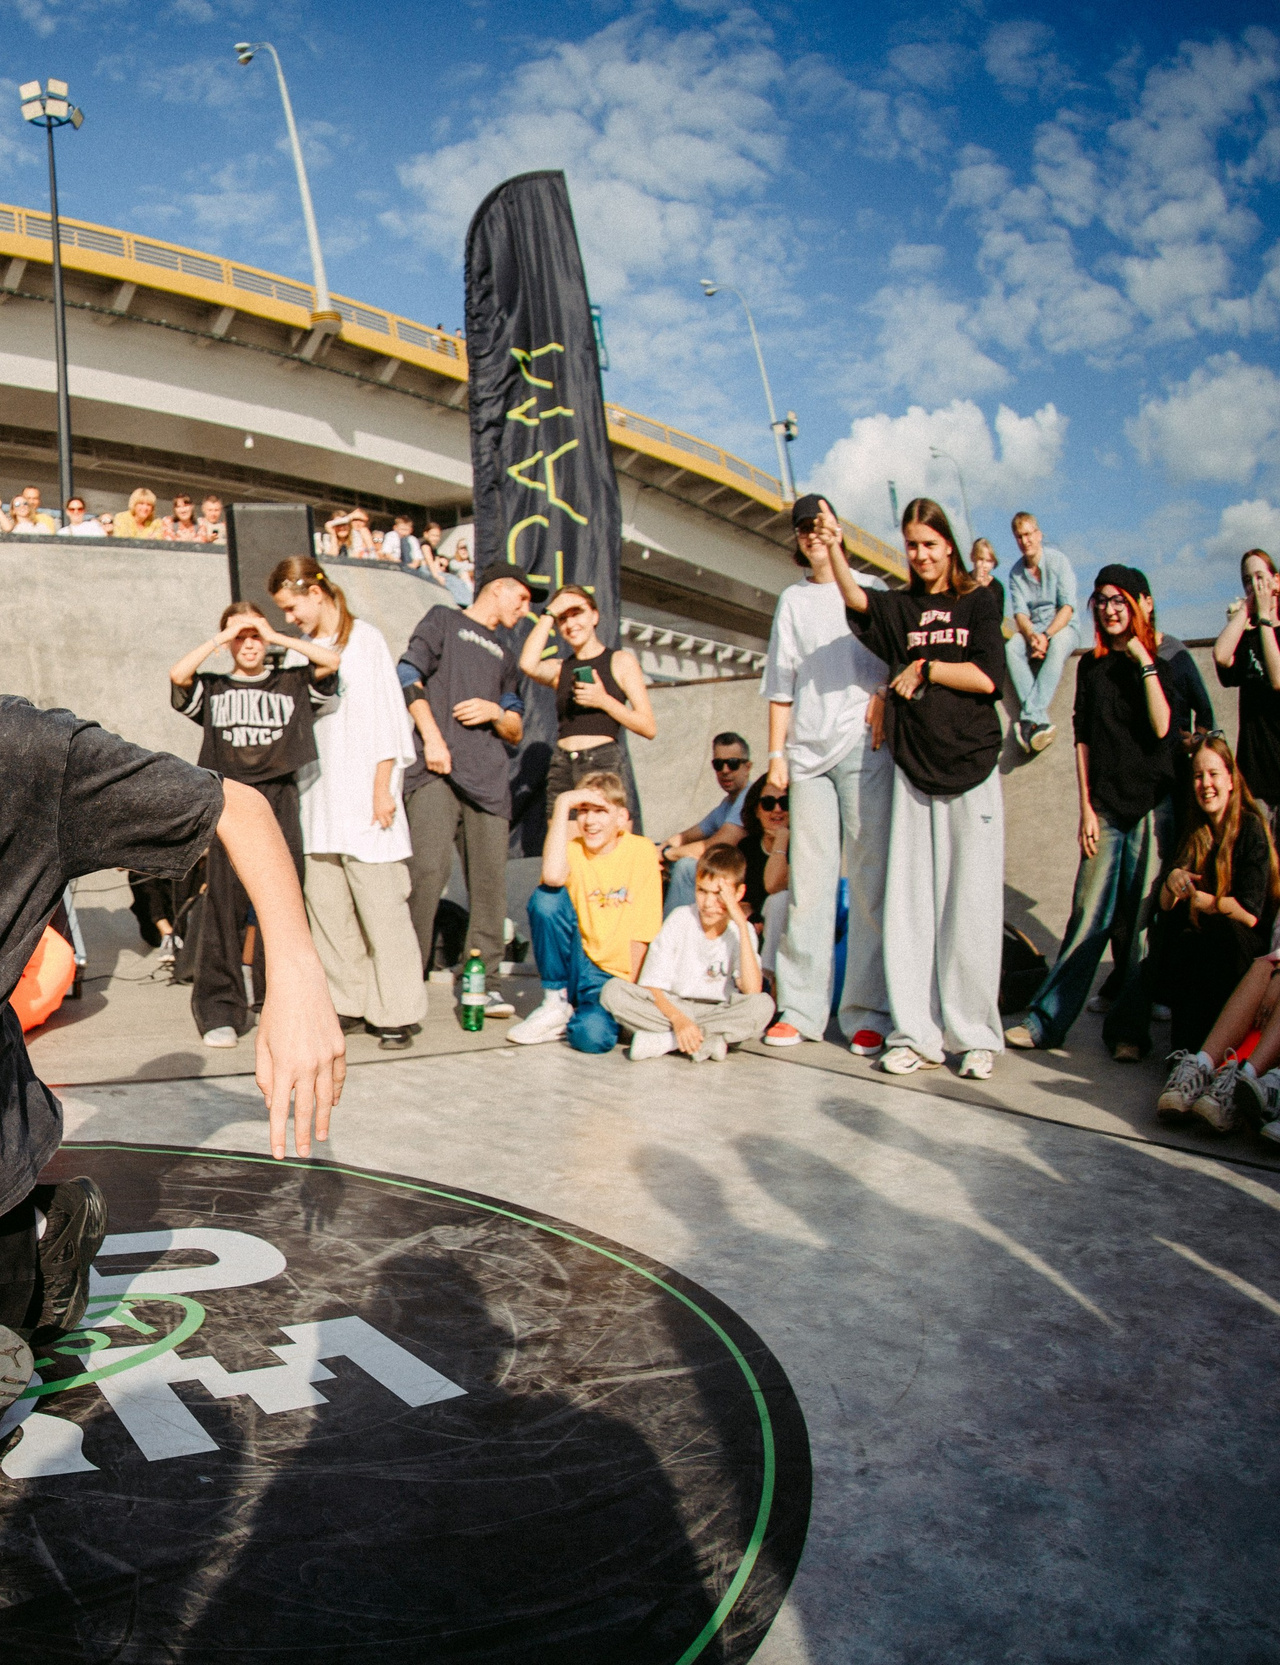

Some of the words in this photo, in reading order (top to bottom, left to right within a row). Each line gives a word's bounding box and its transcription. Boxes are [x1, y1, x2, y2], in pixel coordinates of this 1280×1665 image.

[506, 342, 596, 659] РАМ
[929, 628, 955, 645] FILE
[956, 628, 970, 648] IT
[232, 726, 273, 747] NYC
